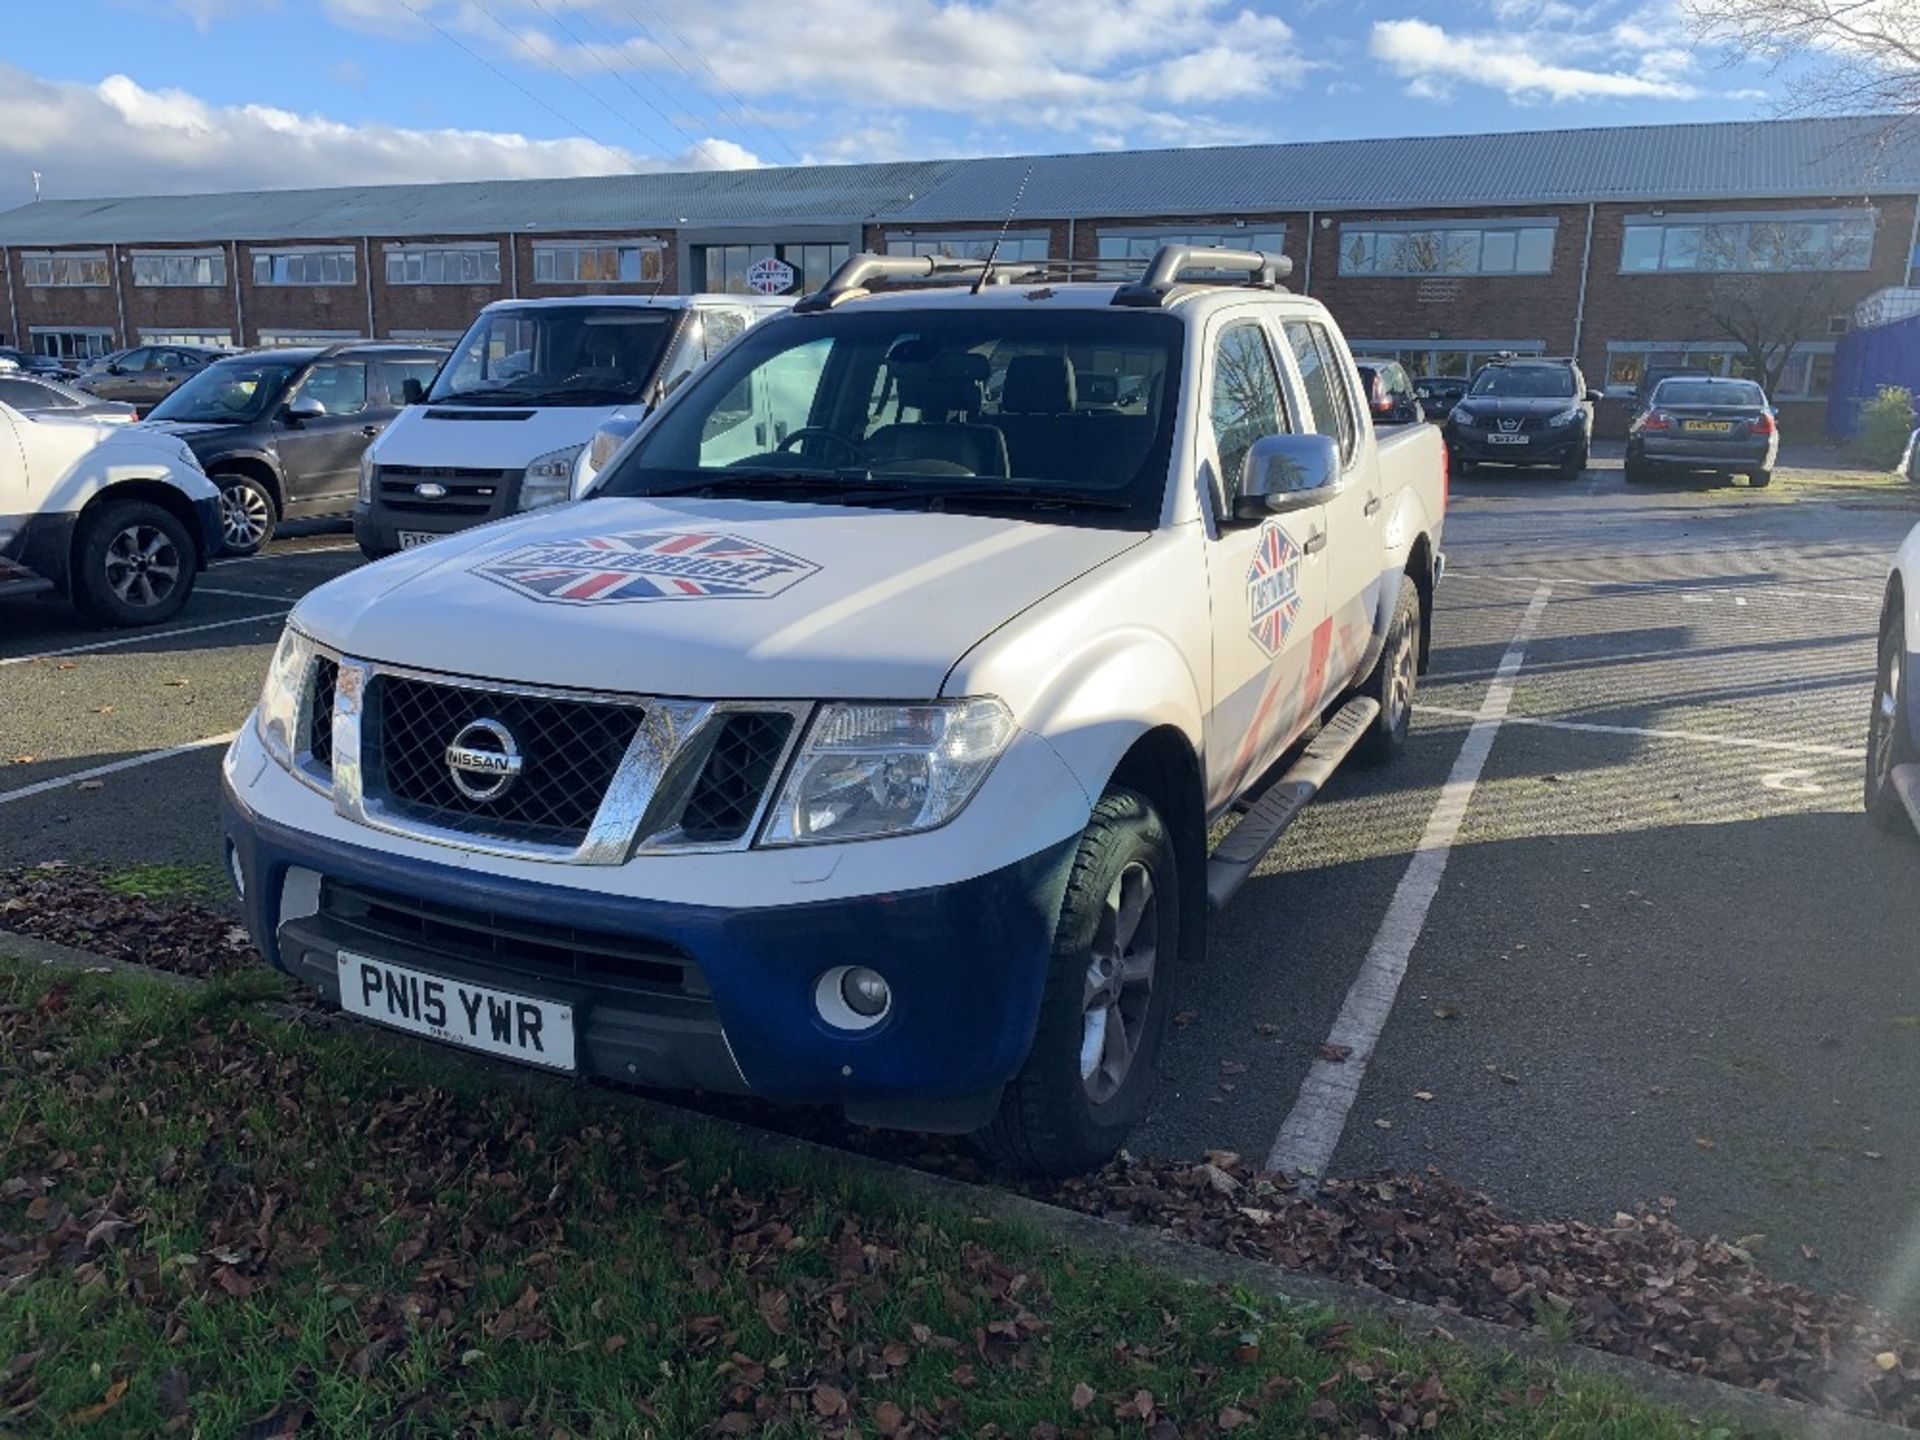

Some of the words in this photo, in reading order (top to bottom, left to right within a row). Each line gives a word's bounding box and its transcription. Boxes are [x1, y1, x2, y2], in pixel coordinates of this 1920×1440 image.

[498, 549, 793, 583] CARTWRIGHT
[448, 749, 509, 770] NISSAN
[360, 963, 447, 1028] PN15
[458, 988, 544, 1052] YWR
